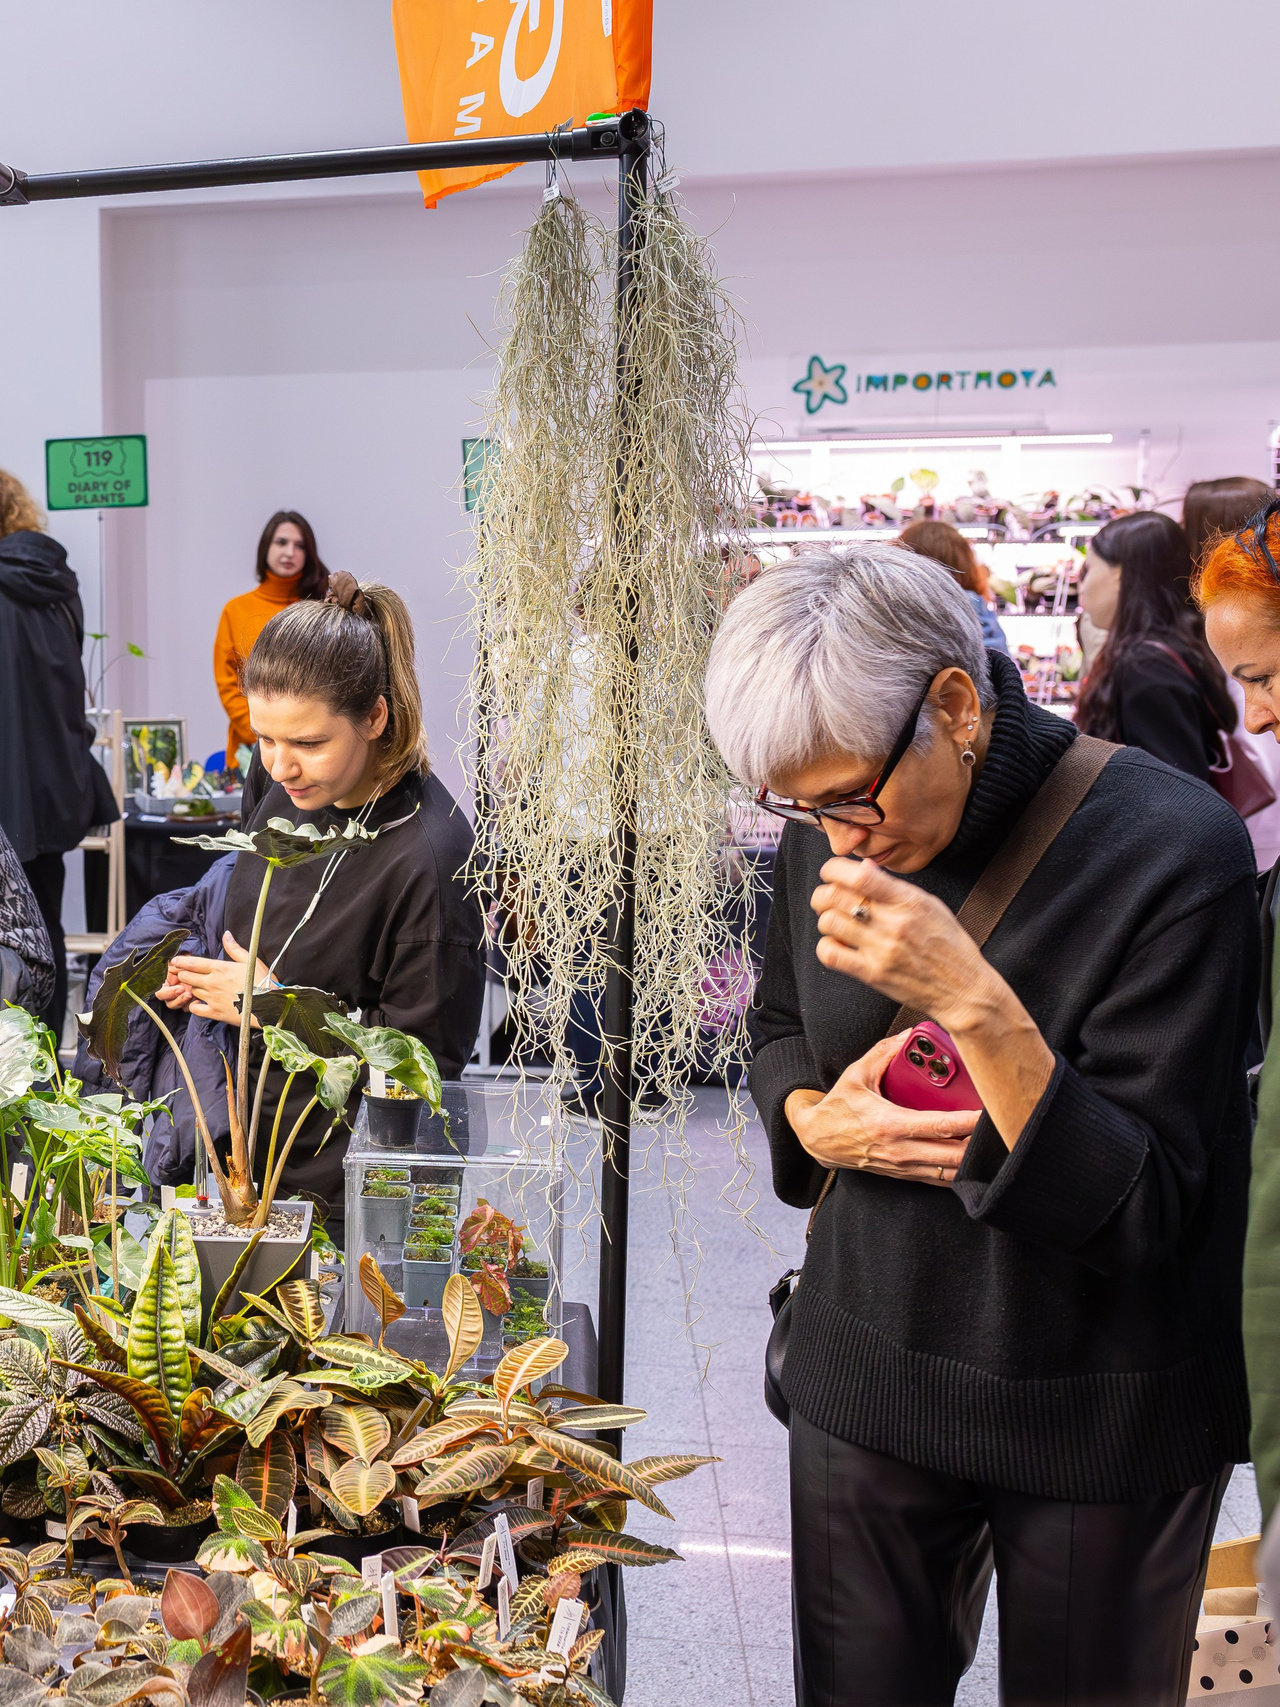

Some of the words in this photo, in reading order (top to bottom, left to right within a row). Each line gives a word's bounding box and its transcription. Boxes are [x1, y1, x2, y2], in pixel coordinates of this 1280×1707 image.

[856, 369, 1057, 393] IMPORTHOYA
[84, 450, 113, 467] 119
[68, 481, 109, 494] DIARY
[113, 480, 131, 492] OF
[75, 493, 125, 505] PLANTS
